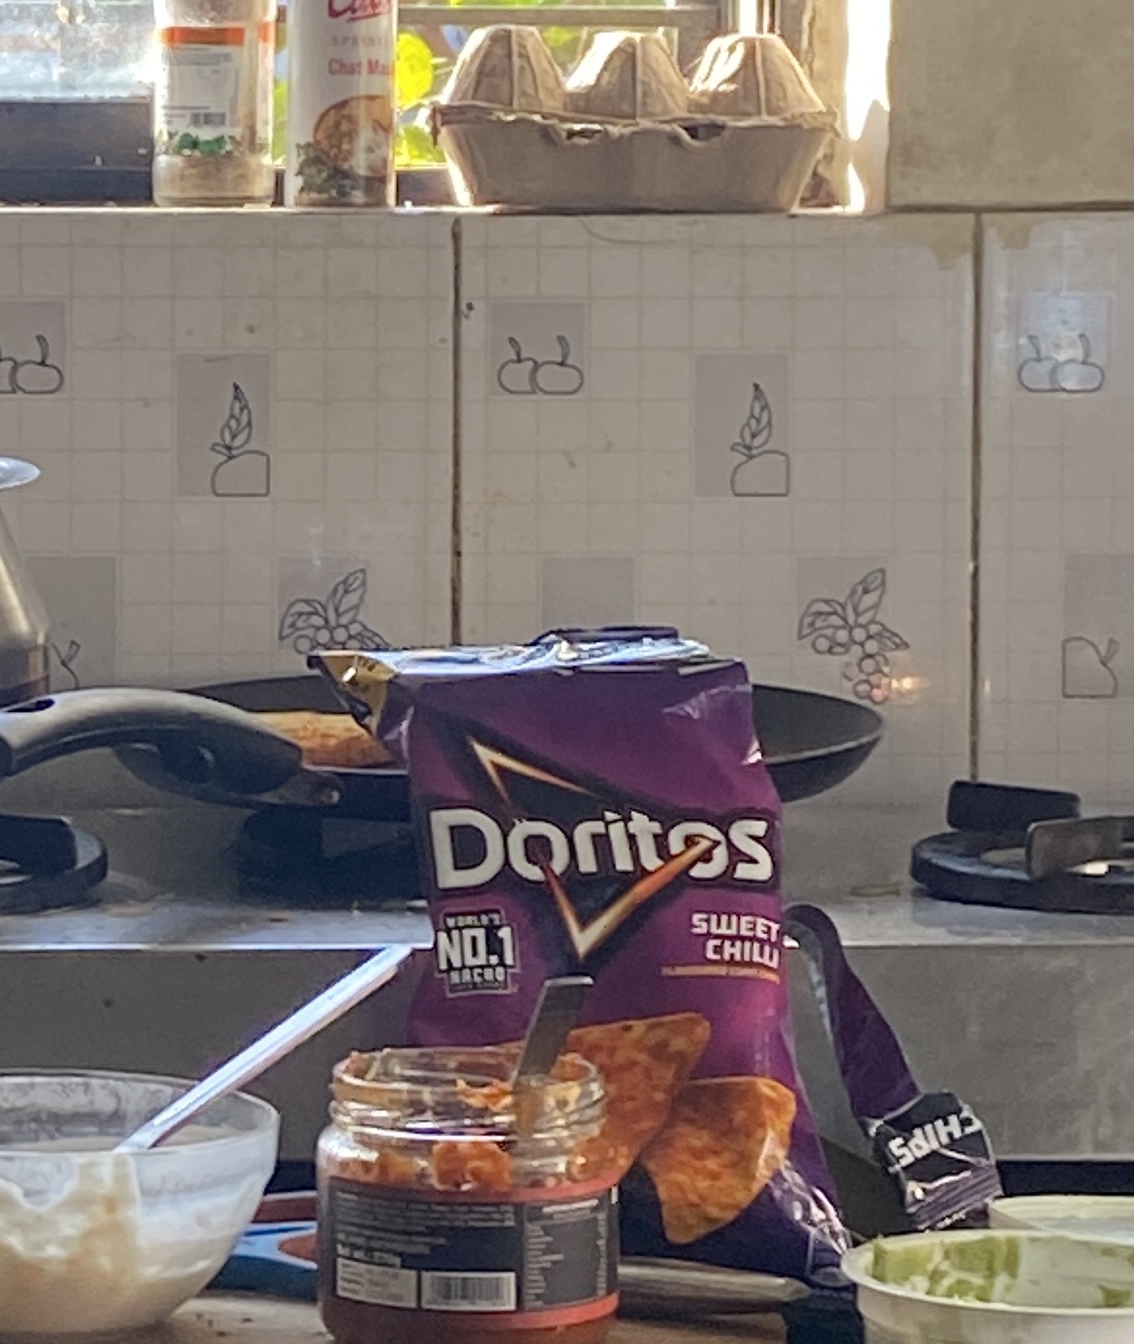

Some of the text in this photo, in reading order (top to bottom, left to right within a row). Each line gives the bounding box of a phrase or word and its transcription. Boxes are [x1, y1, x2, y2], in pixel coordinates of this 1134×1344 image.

[429, 807, 774, 890] Doritos
[437, 926, 515, 971] NO.1
[690, 912, 781, 942] SWEET
